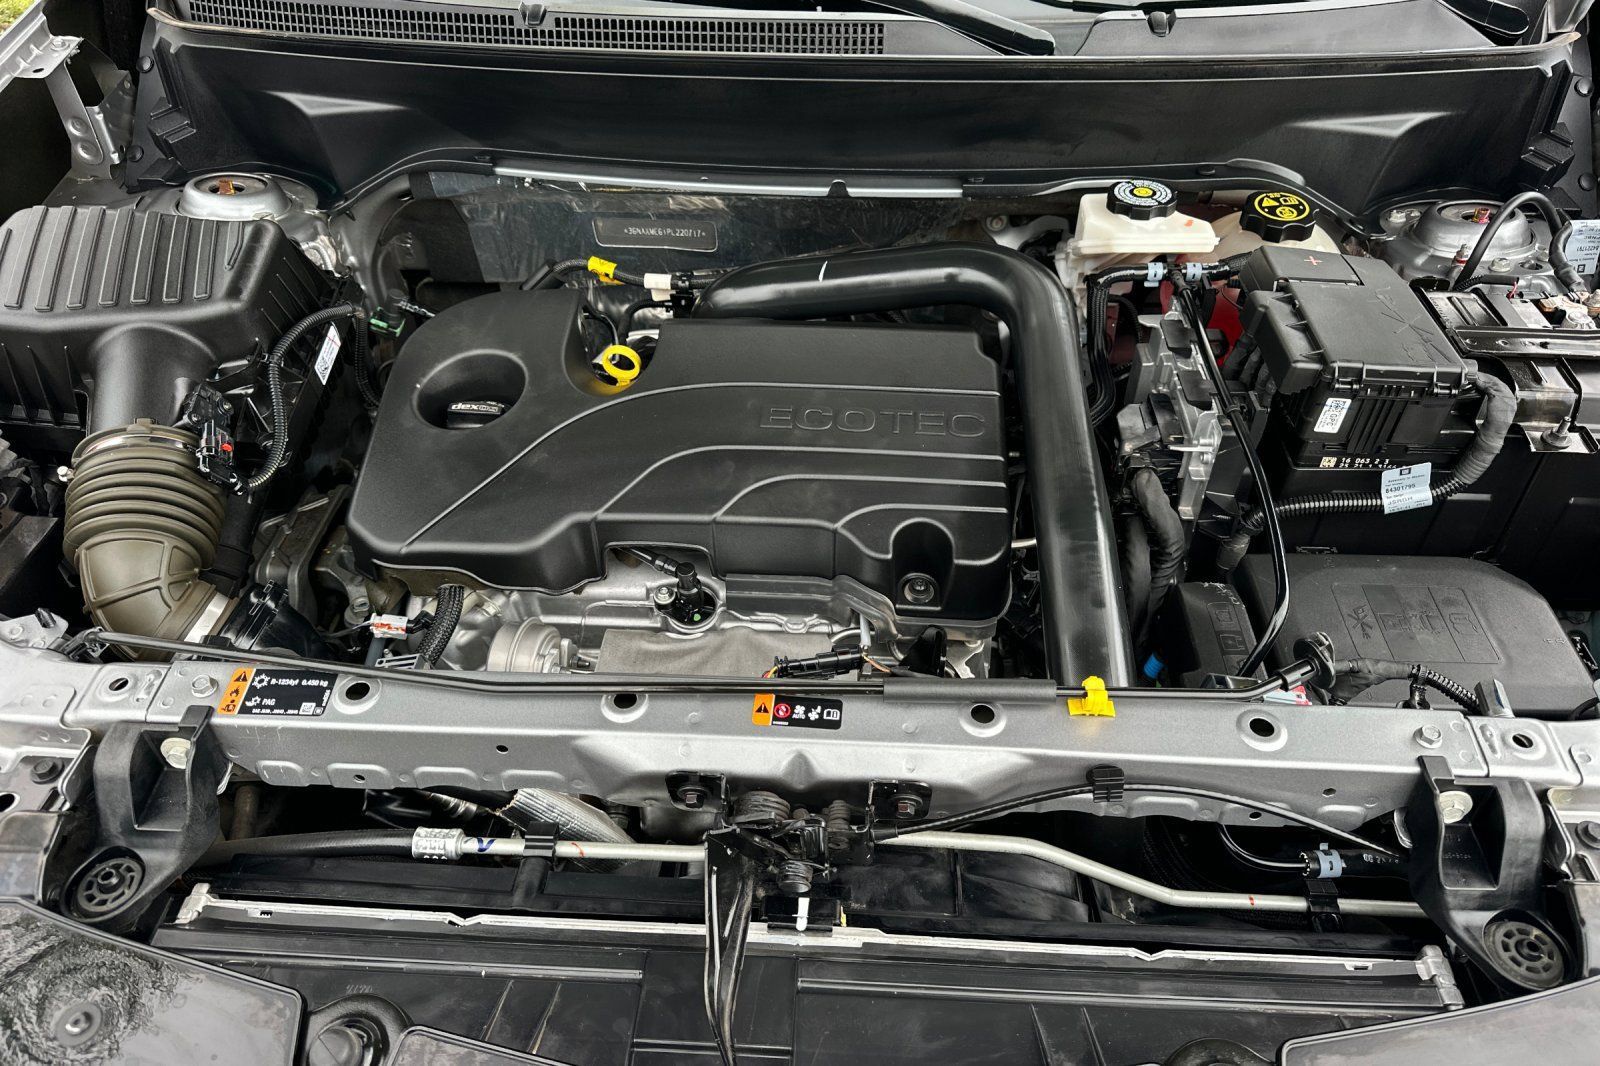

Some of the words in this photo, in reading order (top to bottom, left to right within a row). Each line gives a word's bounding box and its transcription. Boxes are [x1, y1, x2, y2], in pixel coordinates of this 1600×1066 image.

[759, 407, 986, 438] ECOTEC
[270, 678, 299, 686] R-1234yf
[301, 678, 319, 686] 0.450
[320, 679, 329, 688] kg
[261, 698, 276, 706] PAG
